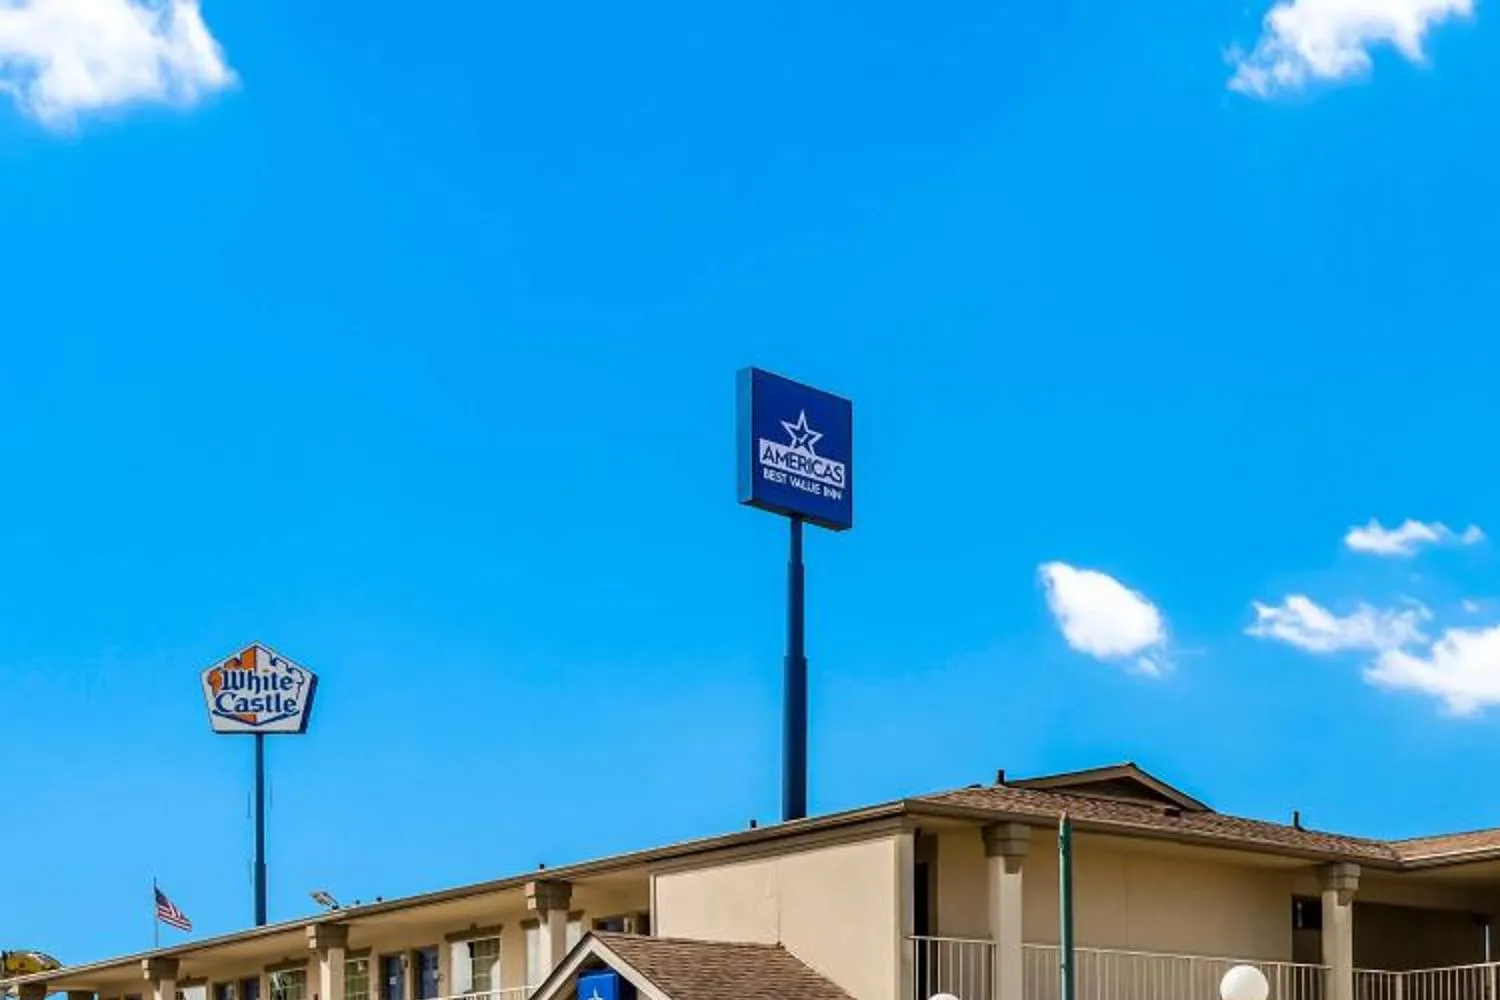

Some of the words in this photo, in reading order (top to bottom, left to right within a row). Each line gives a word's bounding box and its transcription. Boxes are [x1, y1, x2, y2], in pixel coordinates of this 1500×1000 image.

[763, 445, 843, 483] AMERICAS
[763, 468, 787, 485] BEST
[790, 475, 821, 495] VALUE
[823, 486, 842, 500] INN
[222, 671, 293, 694] White
[215, 692, 297, 712] Castle
